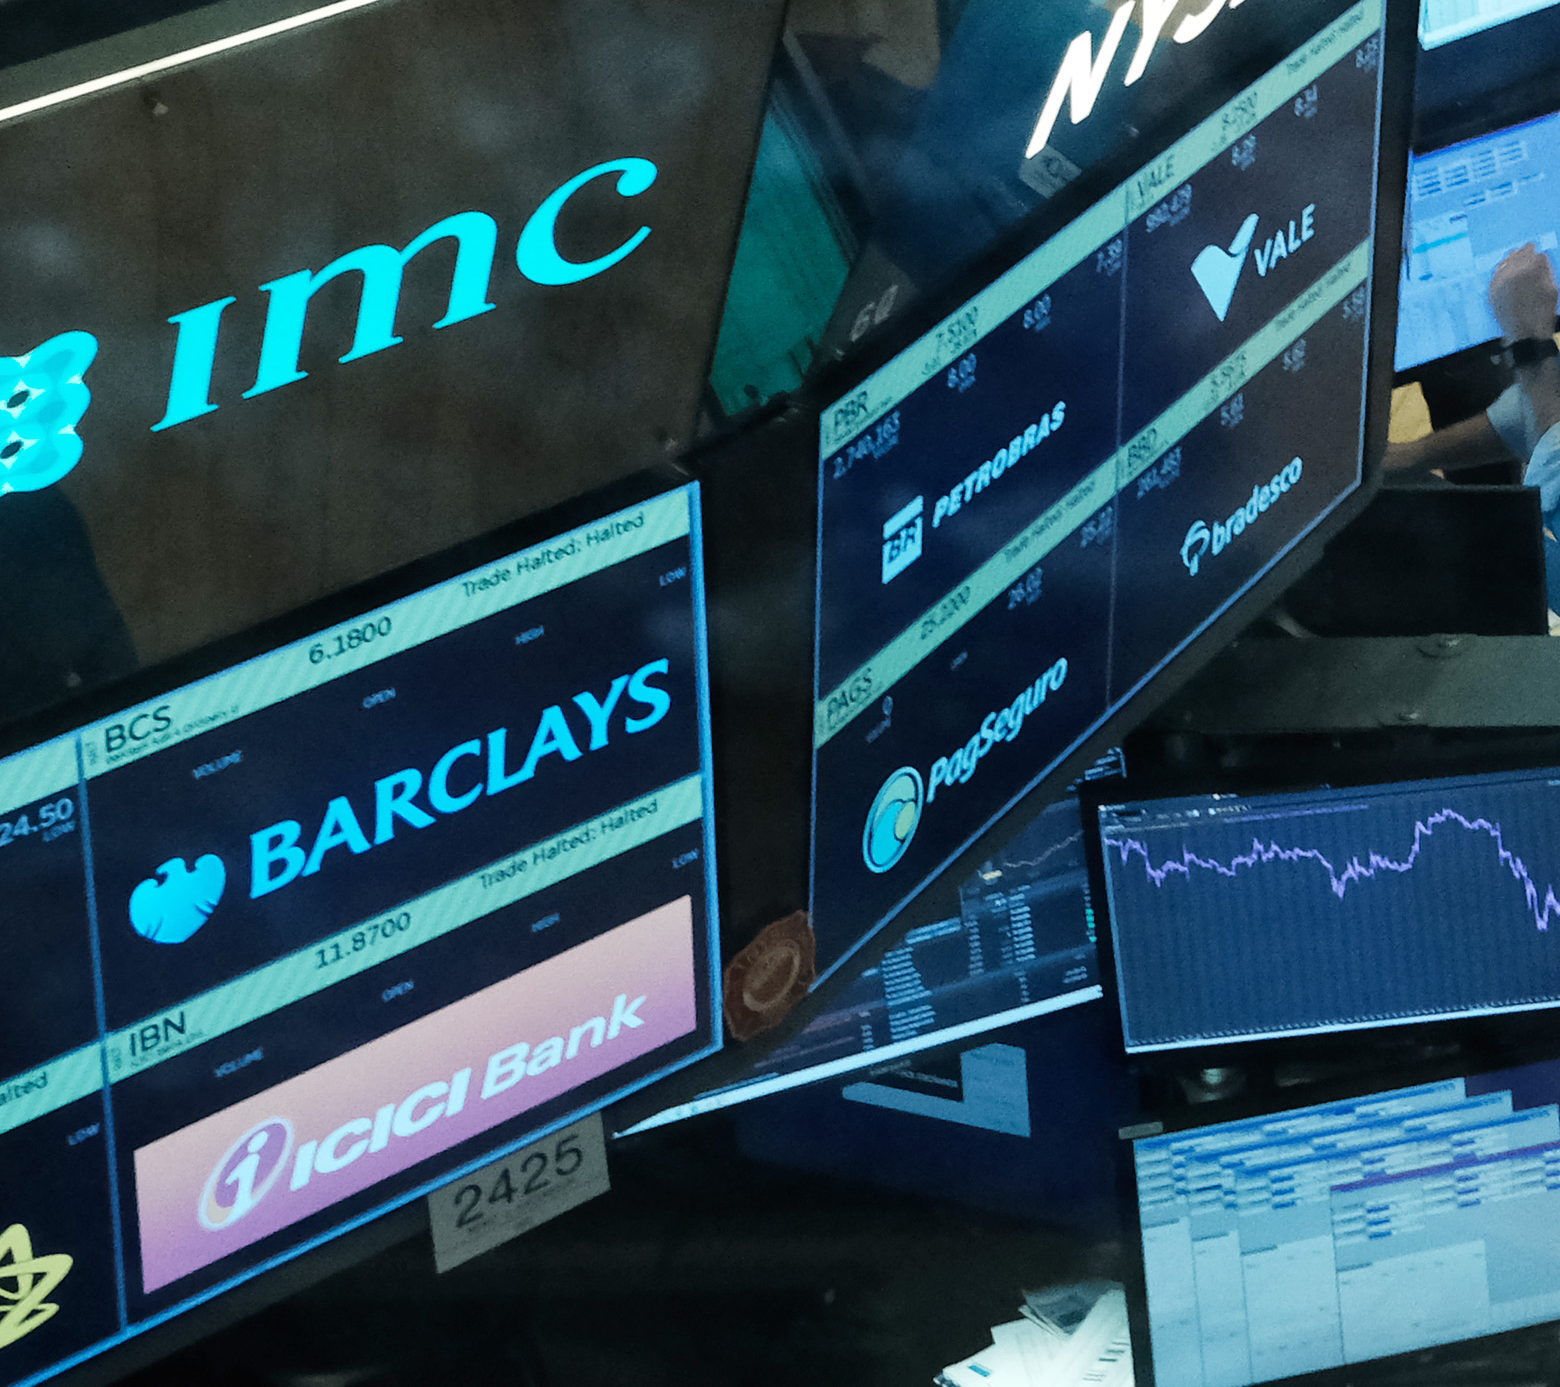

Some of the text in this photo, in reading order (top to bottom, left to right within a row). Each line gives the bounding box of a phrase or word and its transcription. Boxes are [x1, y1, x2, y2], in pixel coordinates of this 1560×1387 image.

[1254, 205, 1316, 277] VALE
[931, 401, 1066, 527] PETROBRAS
[1211, 458, 1303, 557] bradesco
[308, 512, 647, 667] 6.1800 Trade Halted: Halted
[103, 704, 174, 754] BCS
[926, 658, 1069, 804] PagSeguro
[247, 658, 672, 900] BARCLAYS
[313, 911, 413, 971] 11.8700
[127, 1011, 188, 1057] IBN
[289, 993, 647, 1191] ICICI Bank
[454, 1136, 585, 1226] 2425
